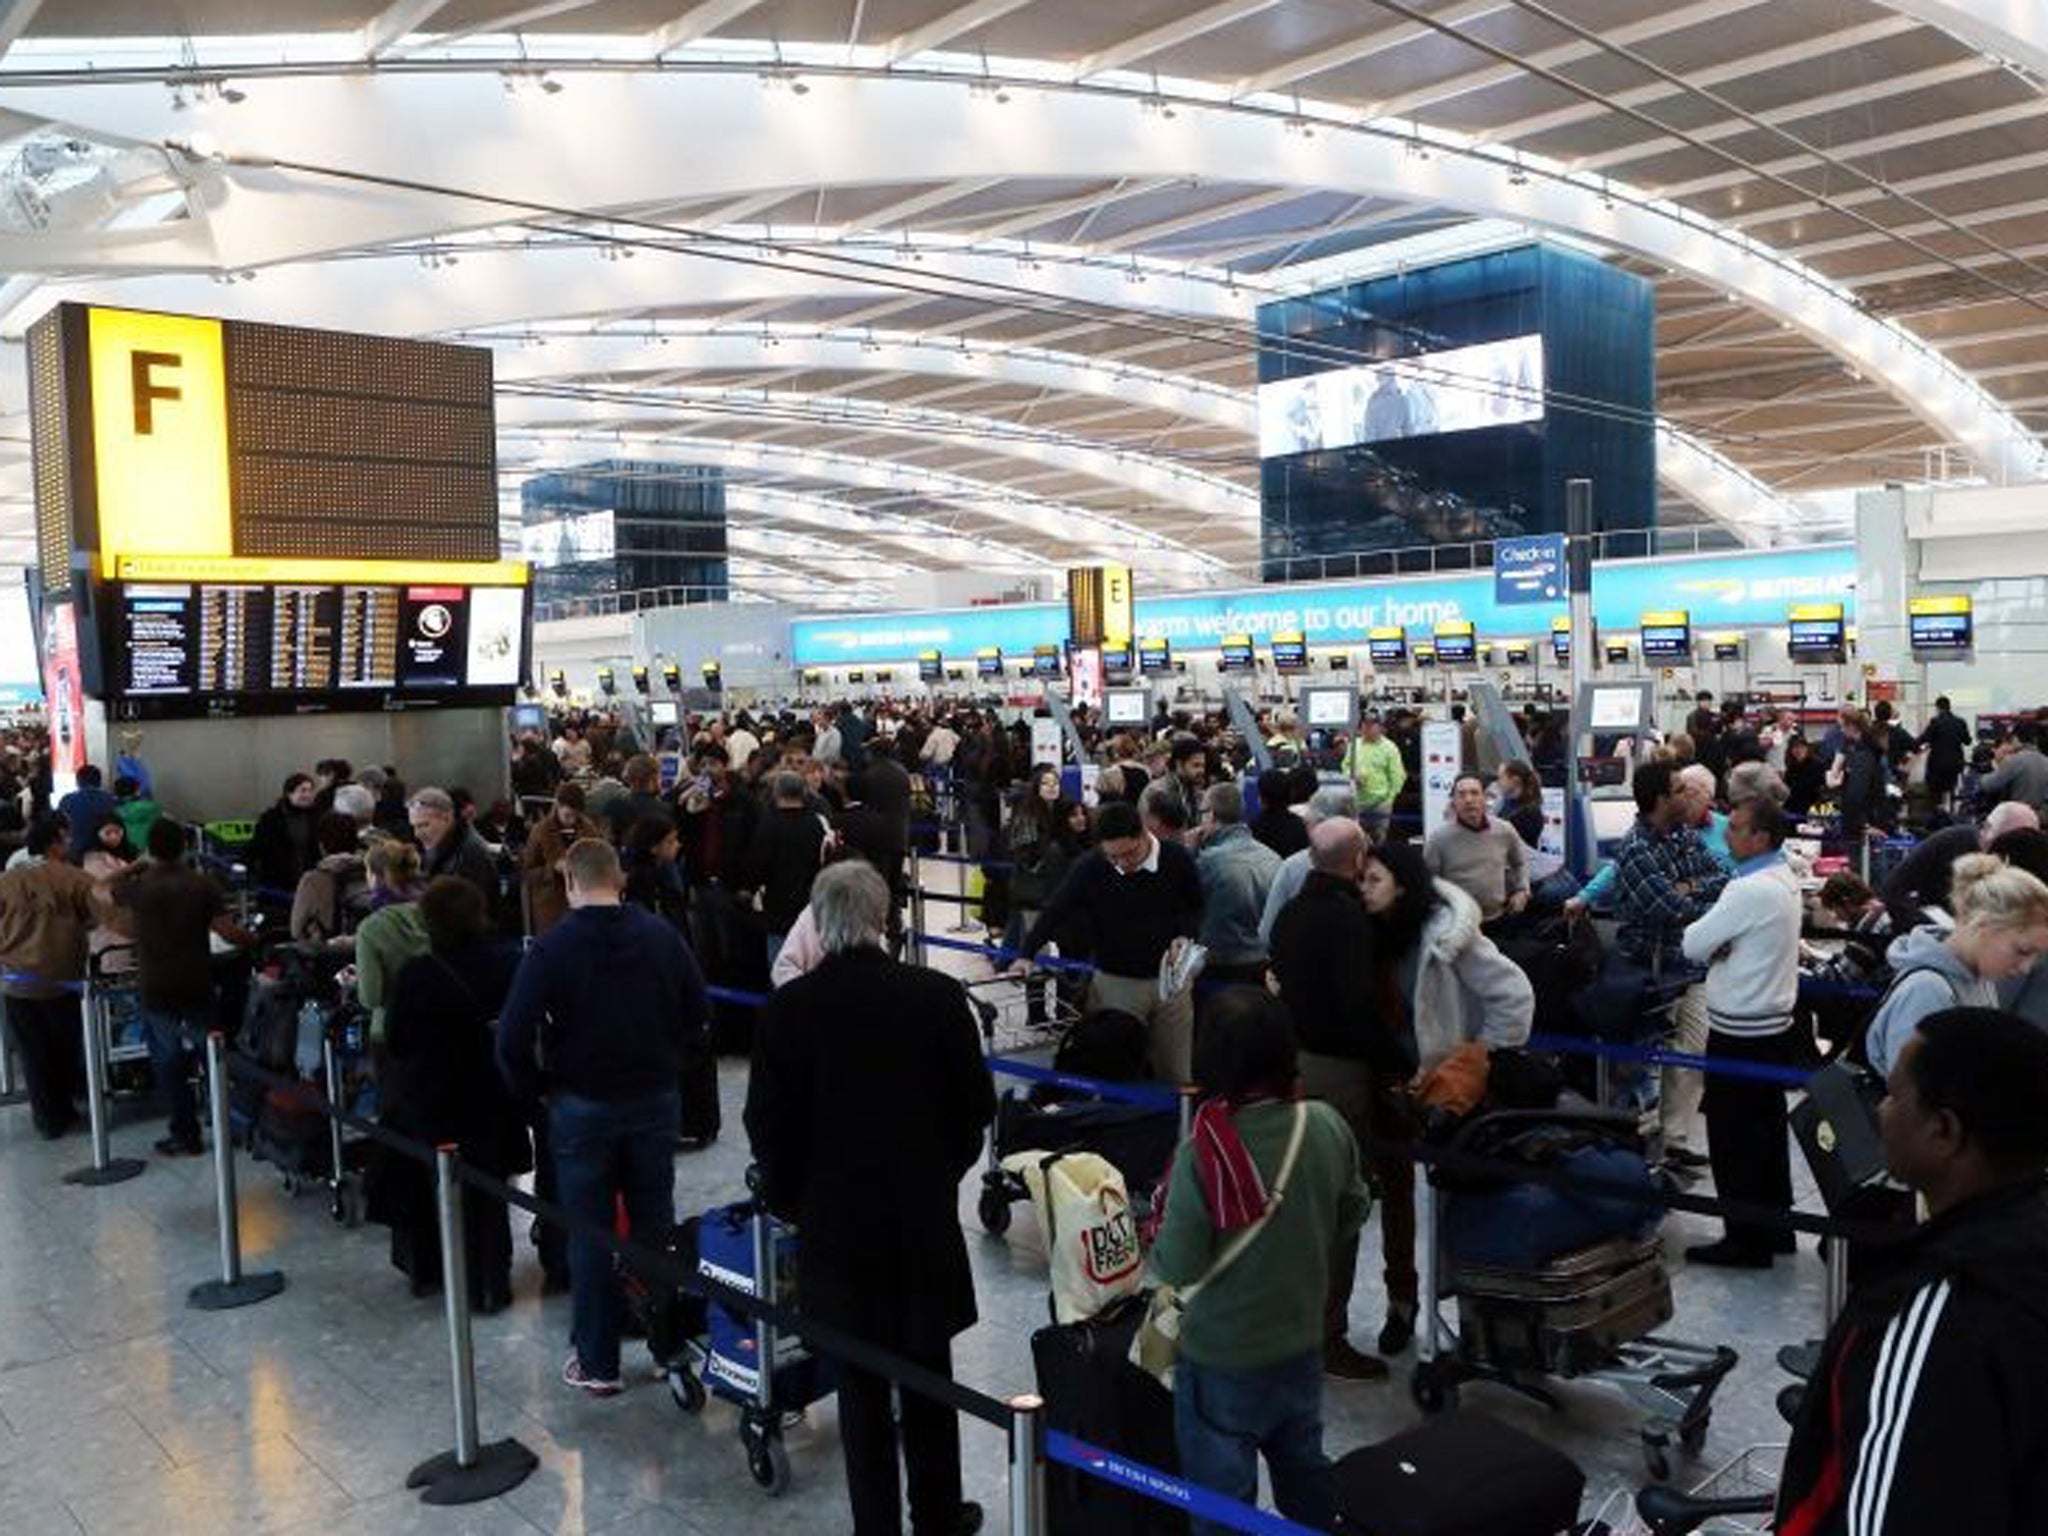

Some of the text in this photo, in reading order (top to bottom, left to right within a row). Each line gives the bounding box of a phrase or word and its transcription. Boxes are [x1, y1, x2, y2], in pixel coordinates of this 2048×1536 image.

[131, 350, 182, 435] F
[1111, 578, 1122, 603] E
[1194, 607, 1297, 636] welcome
[1304, 606, 1330, 630] to
[1335, 604, 1379, 630] our
